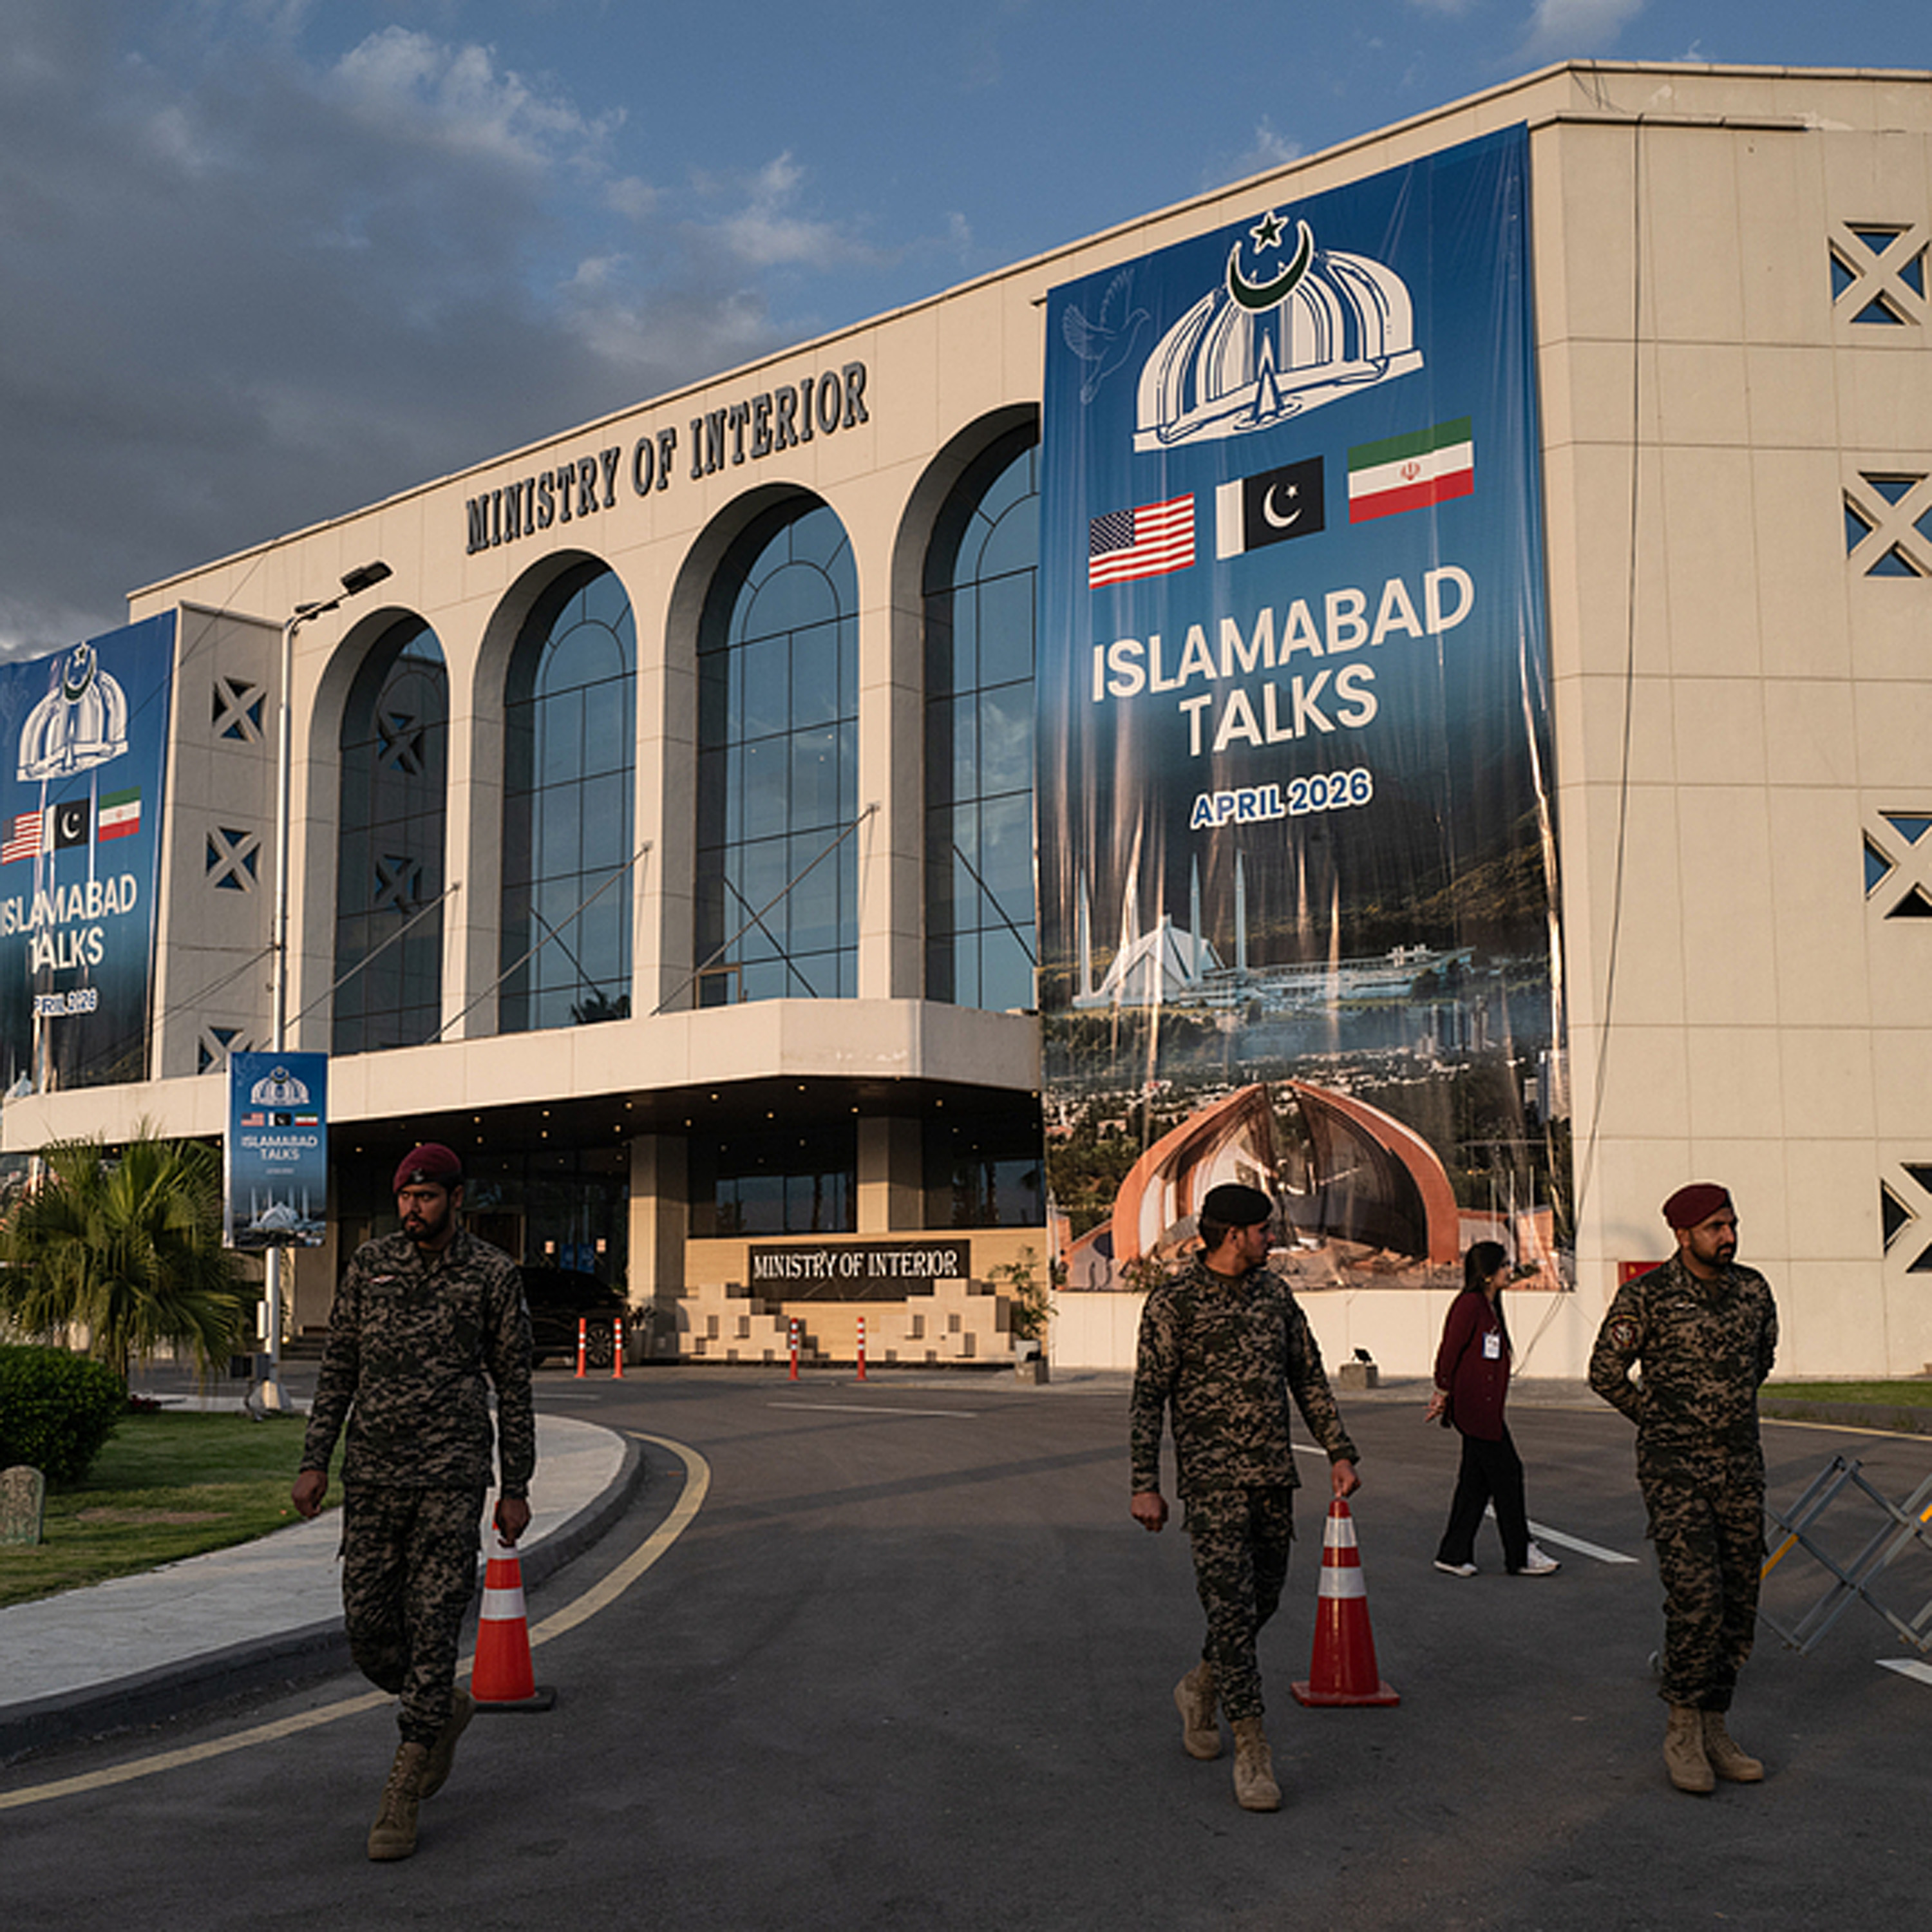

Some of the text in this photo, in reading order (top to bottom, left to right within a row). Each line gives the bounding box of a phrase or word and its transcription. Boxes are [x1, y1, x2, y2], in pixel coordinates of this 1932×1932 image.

[466, 361, 869, 555] MINISTRY OF INTERIOR
[1092, 565, 1475, 703] ISLAMABAD
[1179, 663, 1378, 757] TALKS
[1191, 770, 1371, 827] APRIL 2026
[29, 926, 104, 974] TALKS
[241, 1135, 318, 1148] ISLAMABAD
[261, 1148, 300, 1161] TALKS
[753, 1249, 958, 1278] MINISTRY OF INTERIOR
